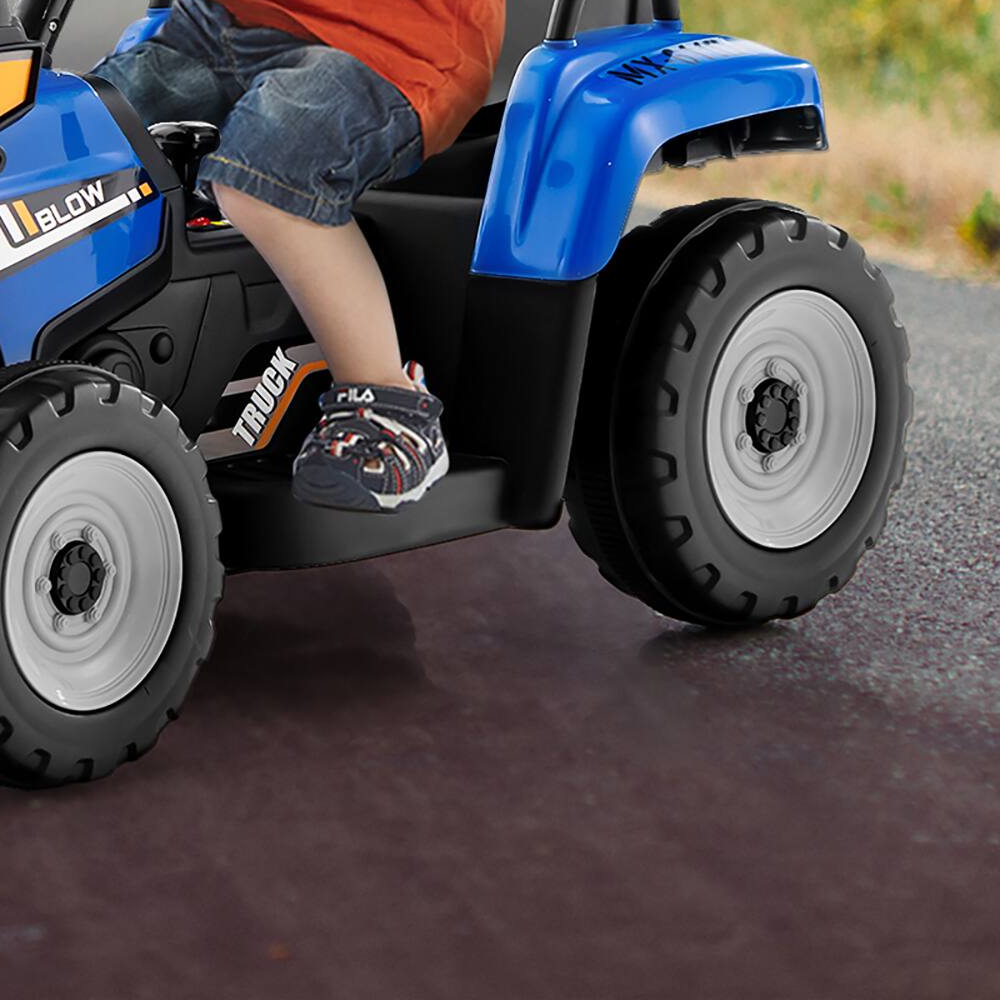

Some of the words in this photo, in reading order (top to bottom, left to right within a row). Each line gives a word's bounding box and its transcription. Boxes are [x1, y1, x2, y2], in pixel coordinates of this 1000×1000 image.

[34, 179, 105, 233] BLOW
[231, 345, 297, 447] TRUCK
[336, 388, 376, 403] FILA
